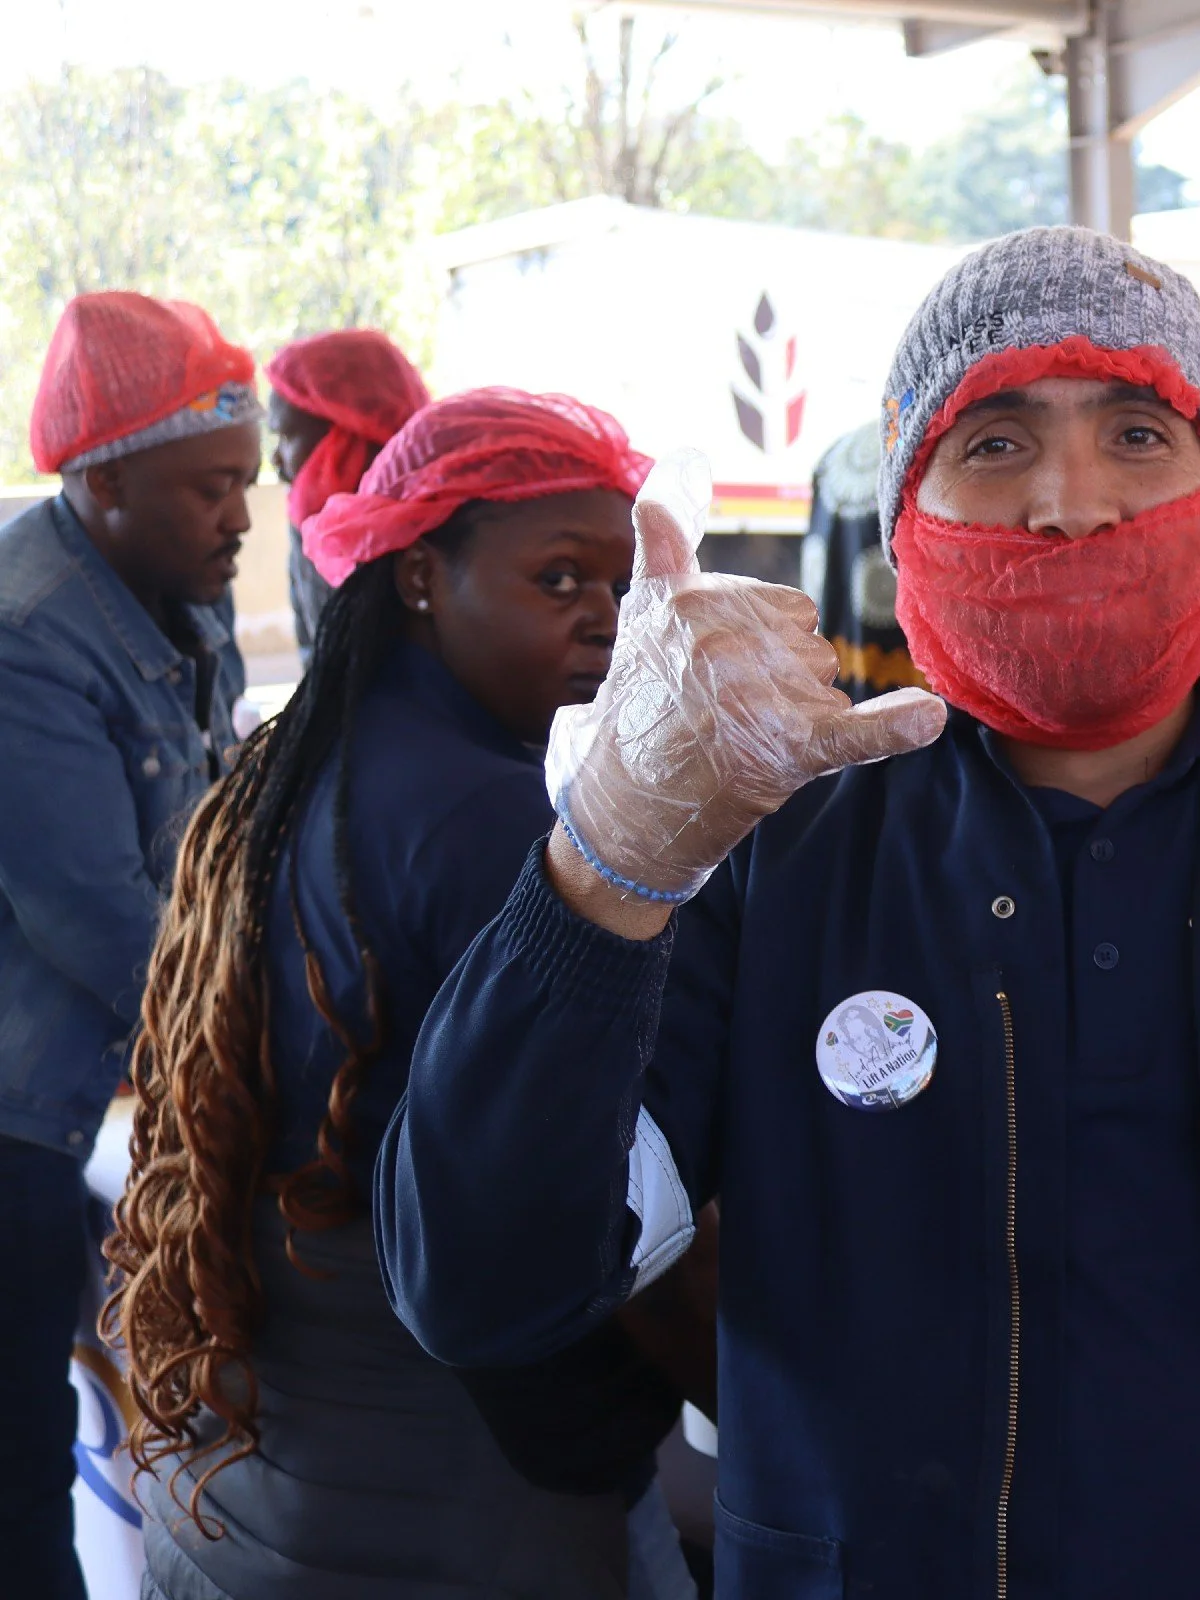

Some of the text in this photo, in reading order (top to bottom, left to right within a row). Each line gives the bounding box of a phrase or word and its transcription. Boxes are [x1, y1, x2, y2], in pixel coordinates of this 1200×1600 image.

[862, 1048, 918, 1089] Lift A Nation
